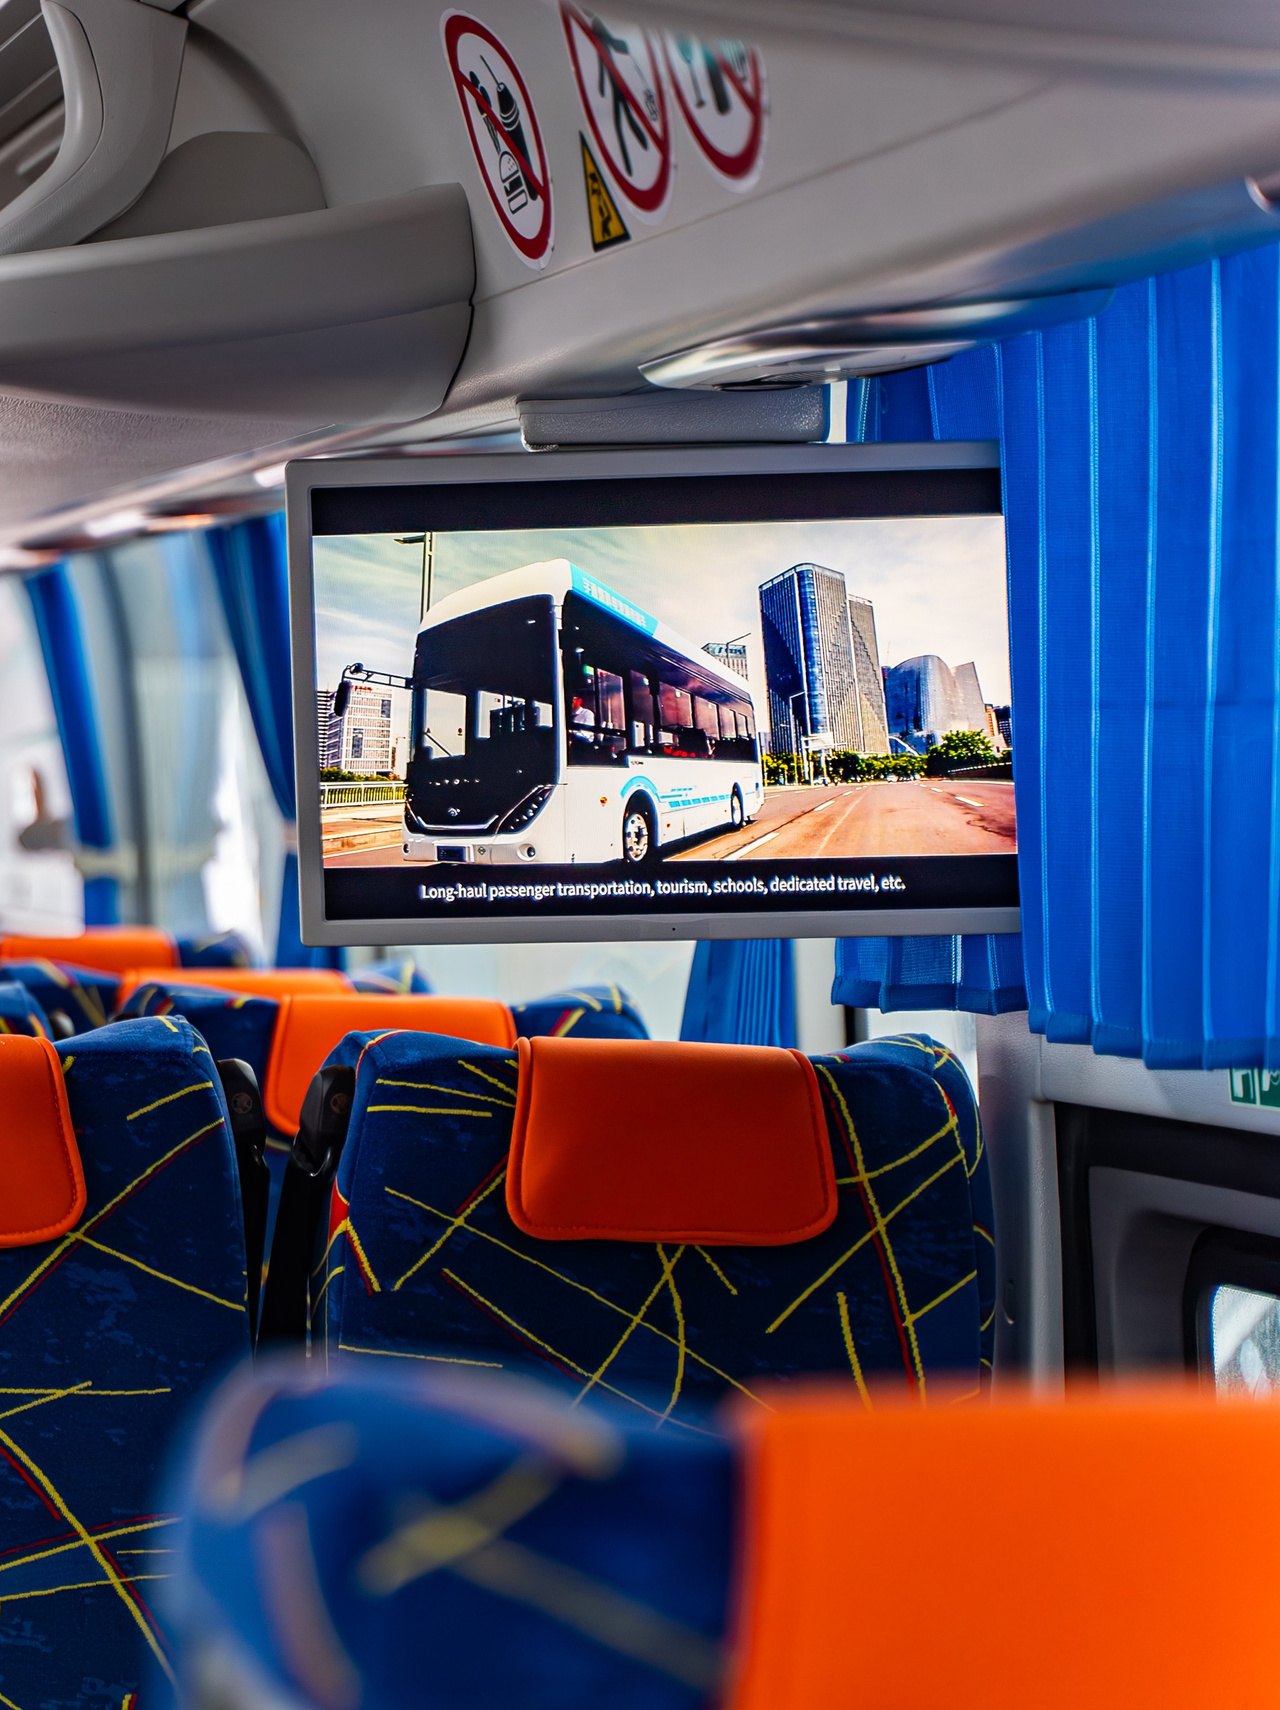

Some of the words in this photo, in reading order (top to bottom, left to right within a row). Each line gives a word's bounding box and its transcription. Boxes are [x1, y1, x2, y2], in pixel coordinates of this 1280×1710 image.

[421, 883, 488, 902] Long-haul
[489, 884, 556, 901] passenger
[557, 879, 655, 900] transportation,
[657, 878, 712, 896] tourism,
[714, 876, 768, 894] schools,
[770, 874, 835, 892] dedicated
[837, 873, 879, 893] travel,
[881, 874, 906, 890] etc.
